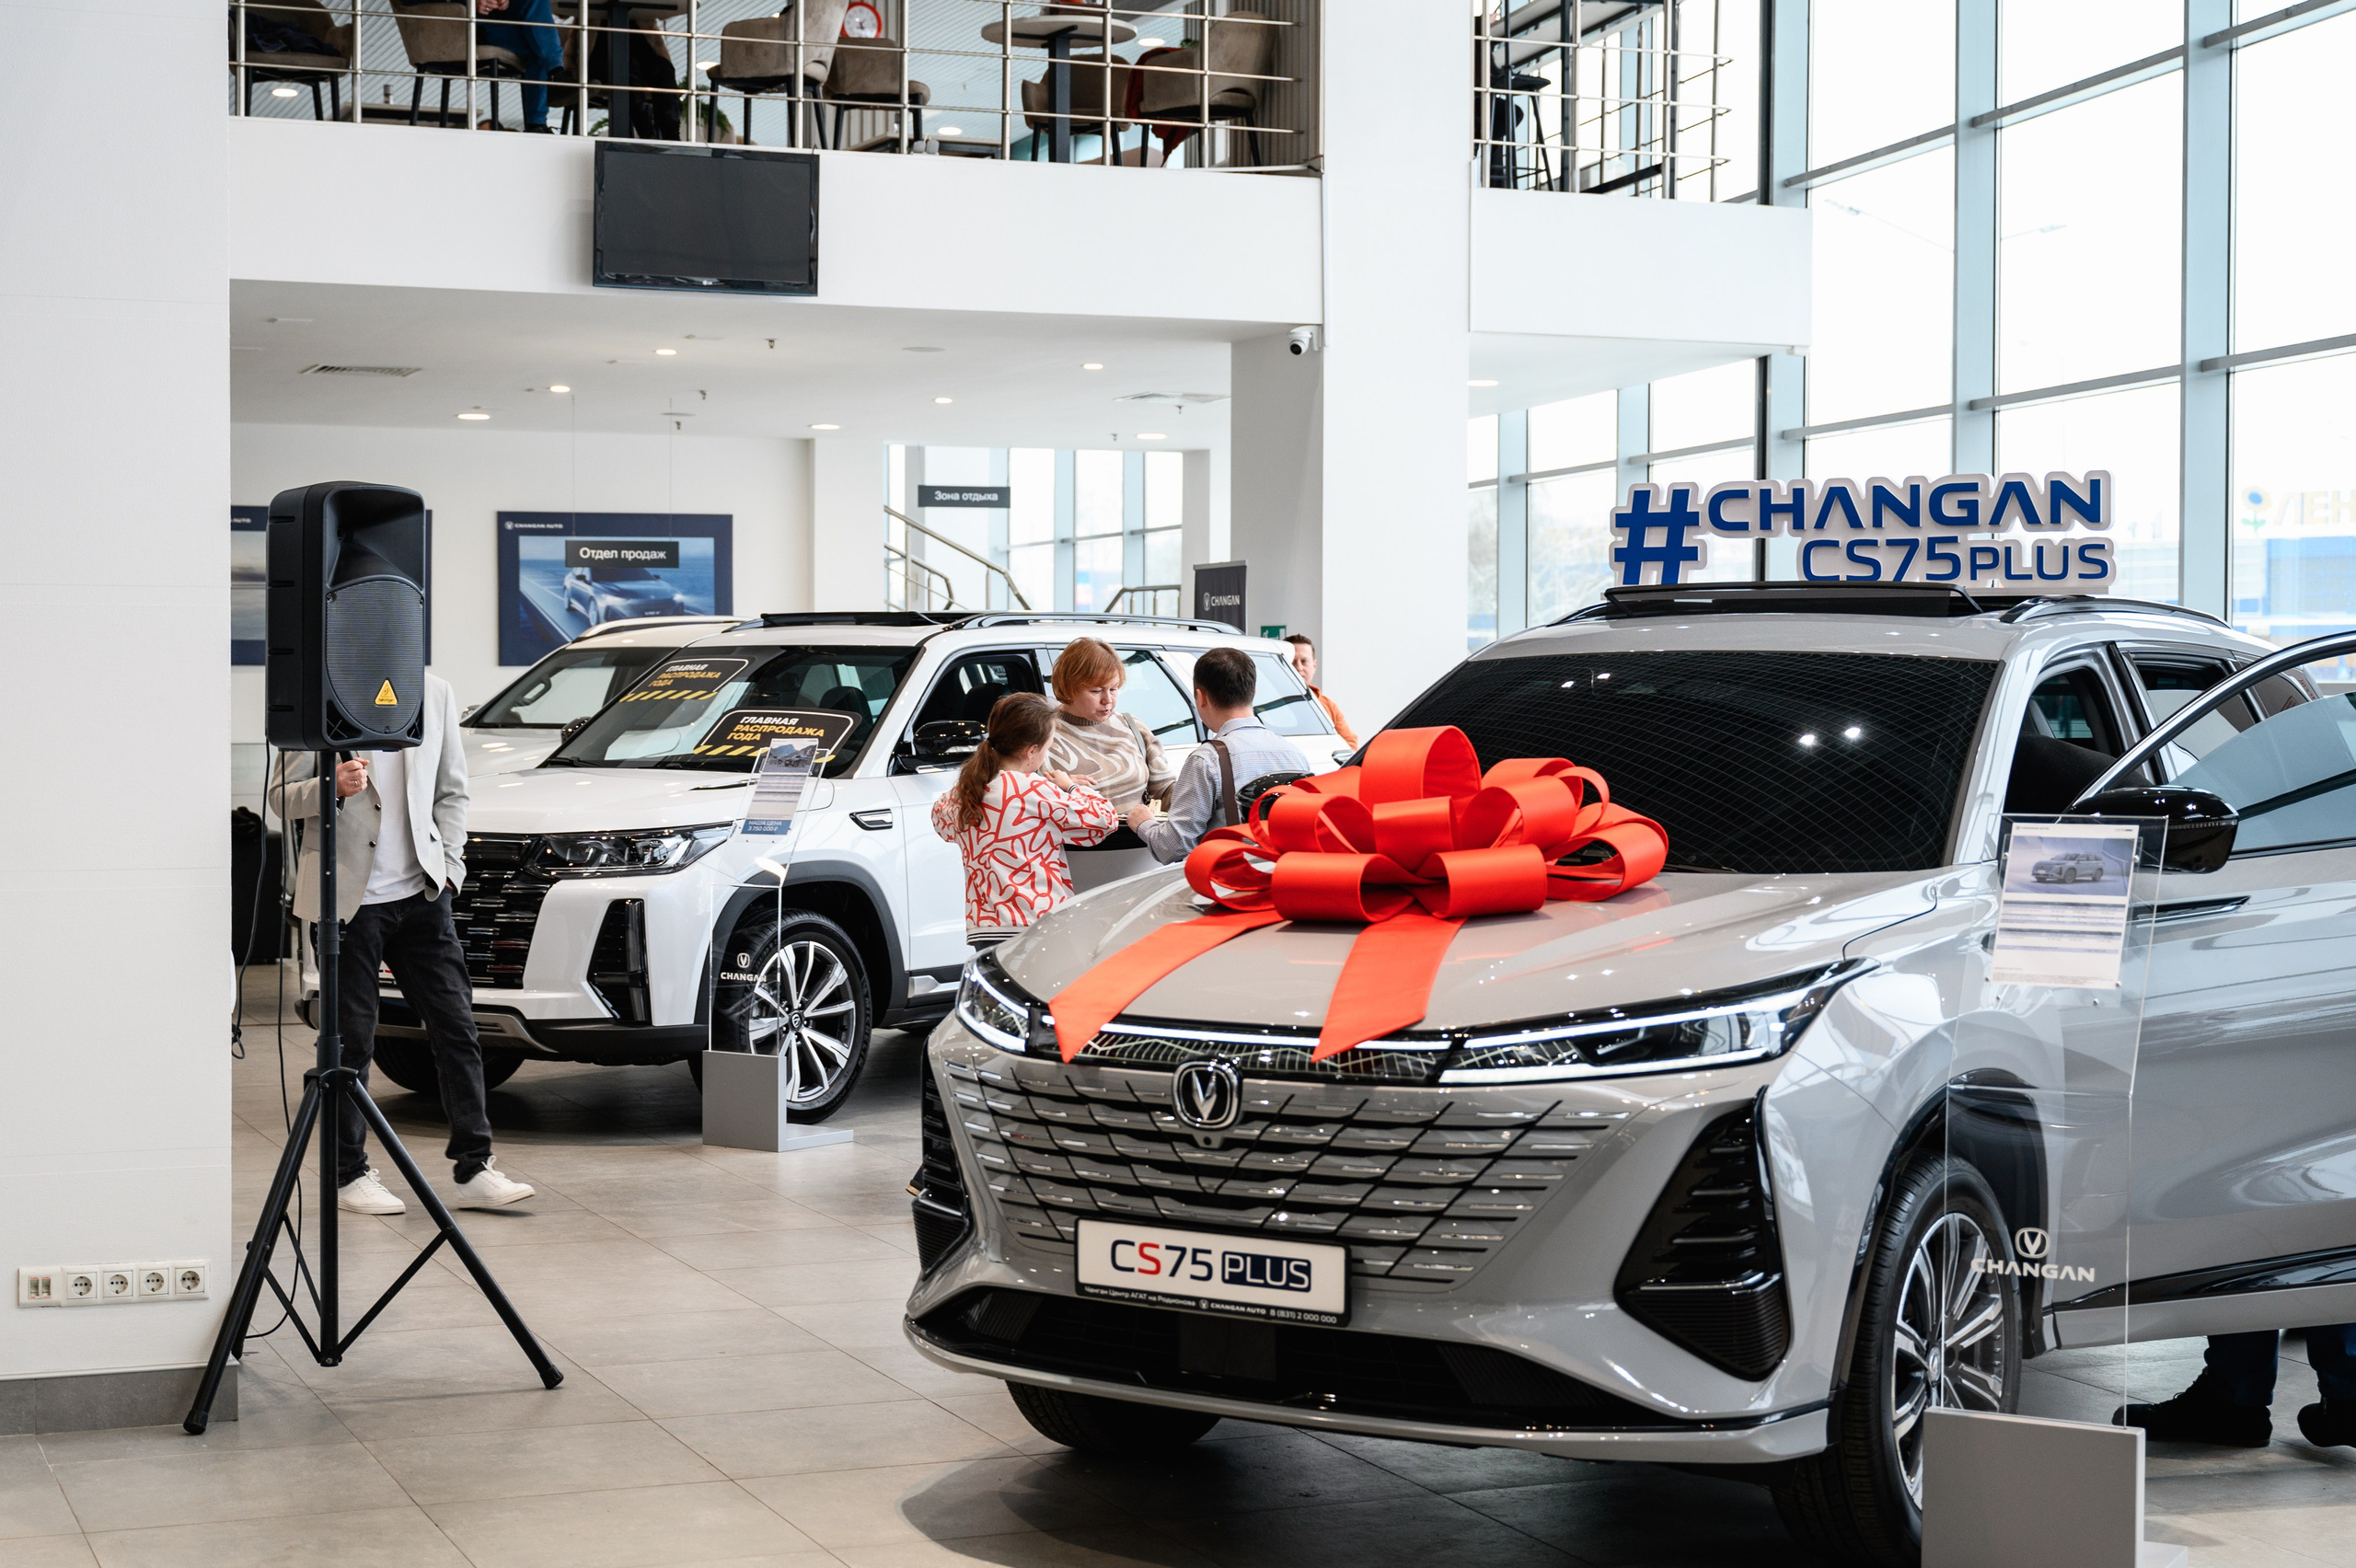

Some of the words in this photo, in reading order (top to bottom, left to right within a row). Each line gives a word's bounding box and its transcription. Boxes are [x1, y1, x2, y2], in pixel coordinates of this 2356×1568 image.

[934, 490, 959, 501] Зона
[962, 492, 999, 502] отдыха
[579, 547, 618, 559] Отдел
[621, 549, 666, 561] продаж
[1210, 594, 1241, 606] CHANGAN
[665, 663, 709, 673] ГЛАВНАЯ
[657, 672, 722, 680] РАСПРОДАЖА
[648, 679, 674, 687] ГОДА
[740, 716, 800, 726] ГЛАВНАЯ
[733, 724, 825, 737] РАСПРОДАЖА
[727, 732, 762, 742] ГОДА
[720, 972, 767, 983] CHANGAN
[1110, 1239, 1213, 1282] CS75
[1223, 1253, 1310, 1288] PLUS
[1970, 1258, 2096, 1283] CHANGAN
[1109, 1289, 1130, 1298] Центр
[1130, 1292, 1148, 1300] АГАТ
[1210, 1302, 1245, 1312] CHANGAN
[1246, 1307, 1266, 1315] AUTO
[1269, 1309, 1276, 1317] 8
[1276, 1309, 1296, 1319] (831)
[1297, 1311, 1302, 1320] 2
[1303, 1312, 1320, 1322] 000
[1320, 1314, 1337, 1324] 000
